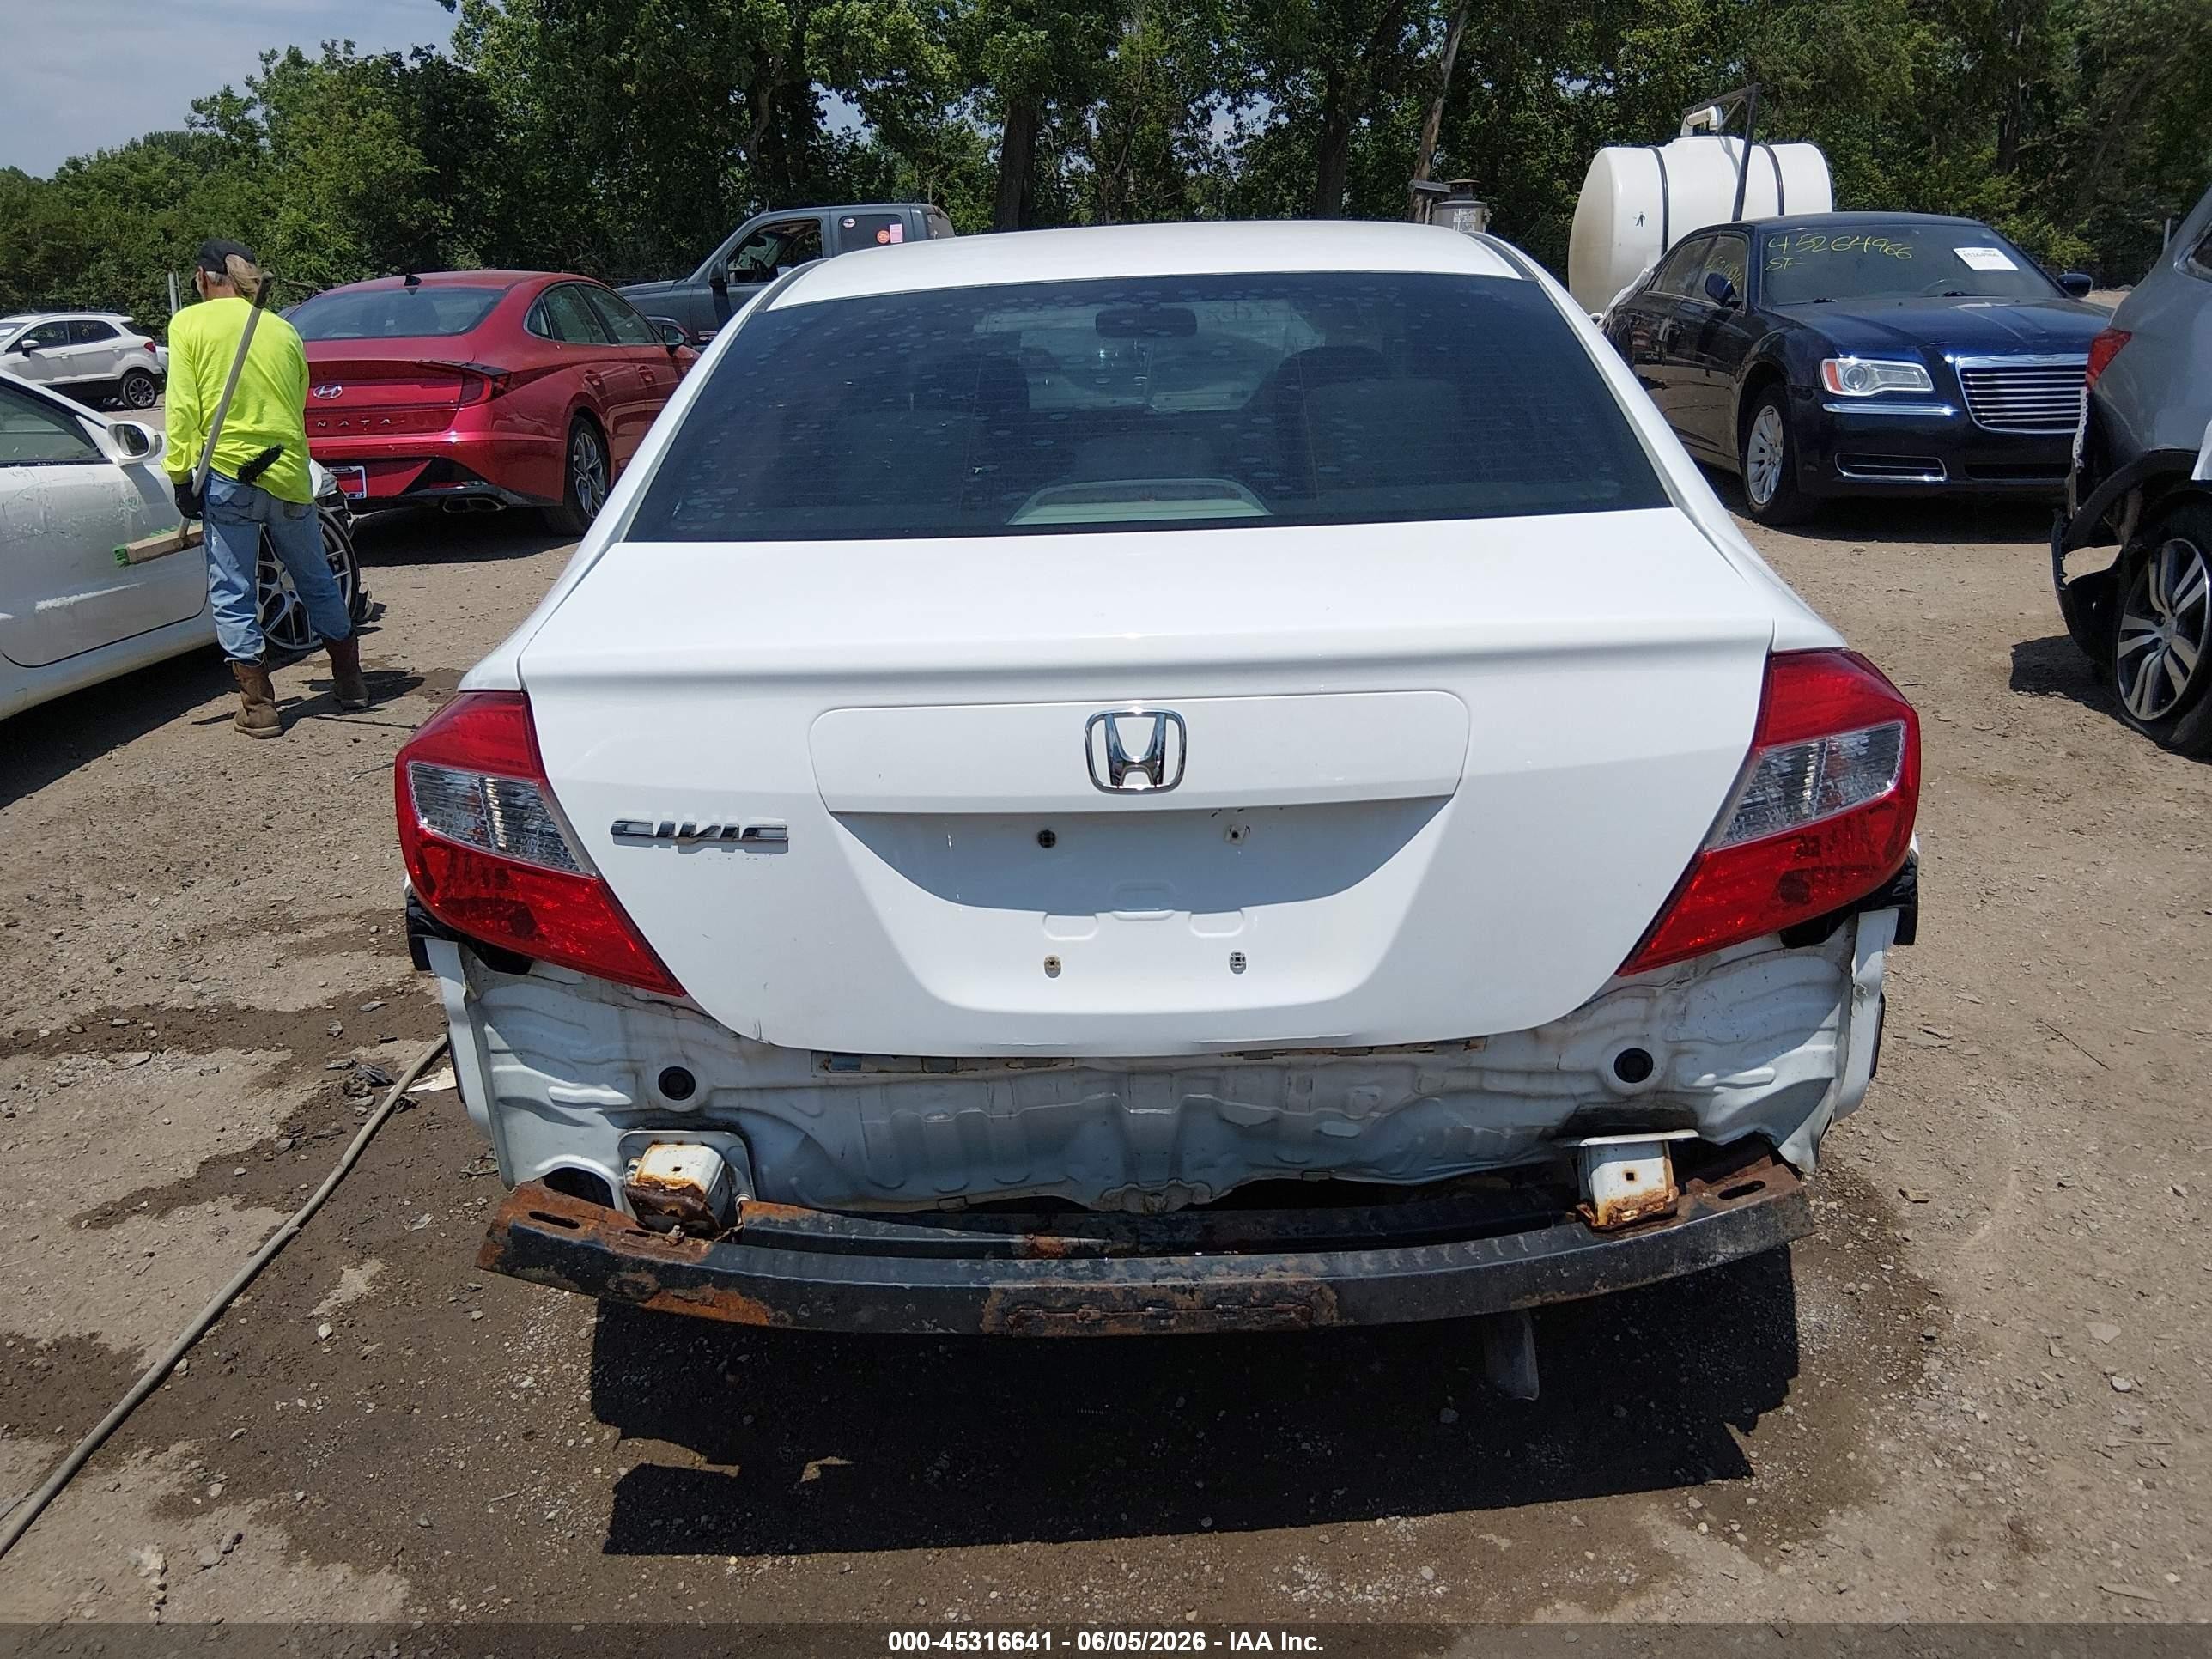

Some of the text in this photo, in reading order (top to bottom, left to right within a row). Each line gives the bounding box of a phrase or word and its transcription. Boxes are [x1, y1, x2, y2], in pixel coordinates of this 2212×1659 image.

[1768, 233, 1913, 259] 45264966
[317, 418, 392, 427] NATA
[611, 820, 788, 843] CIVIC
